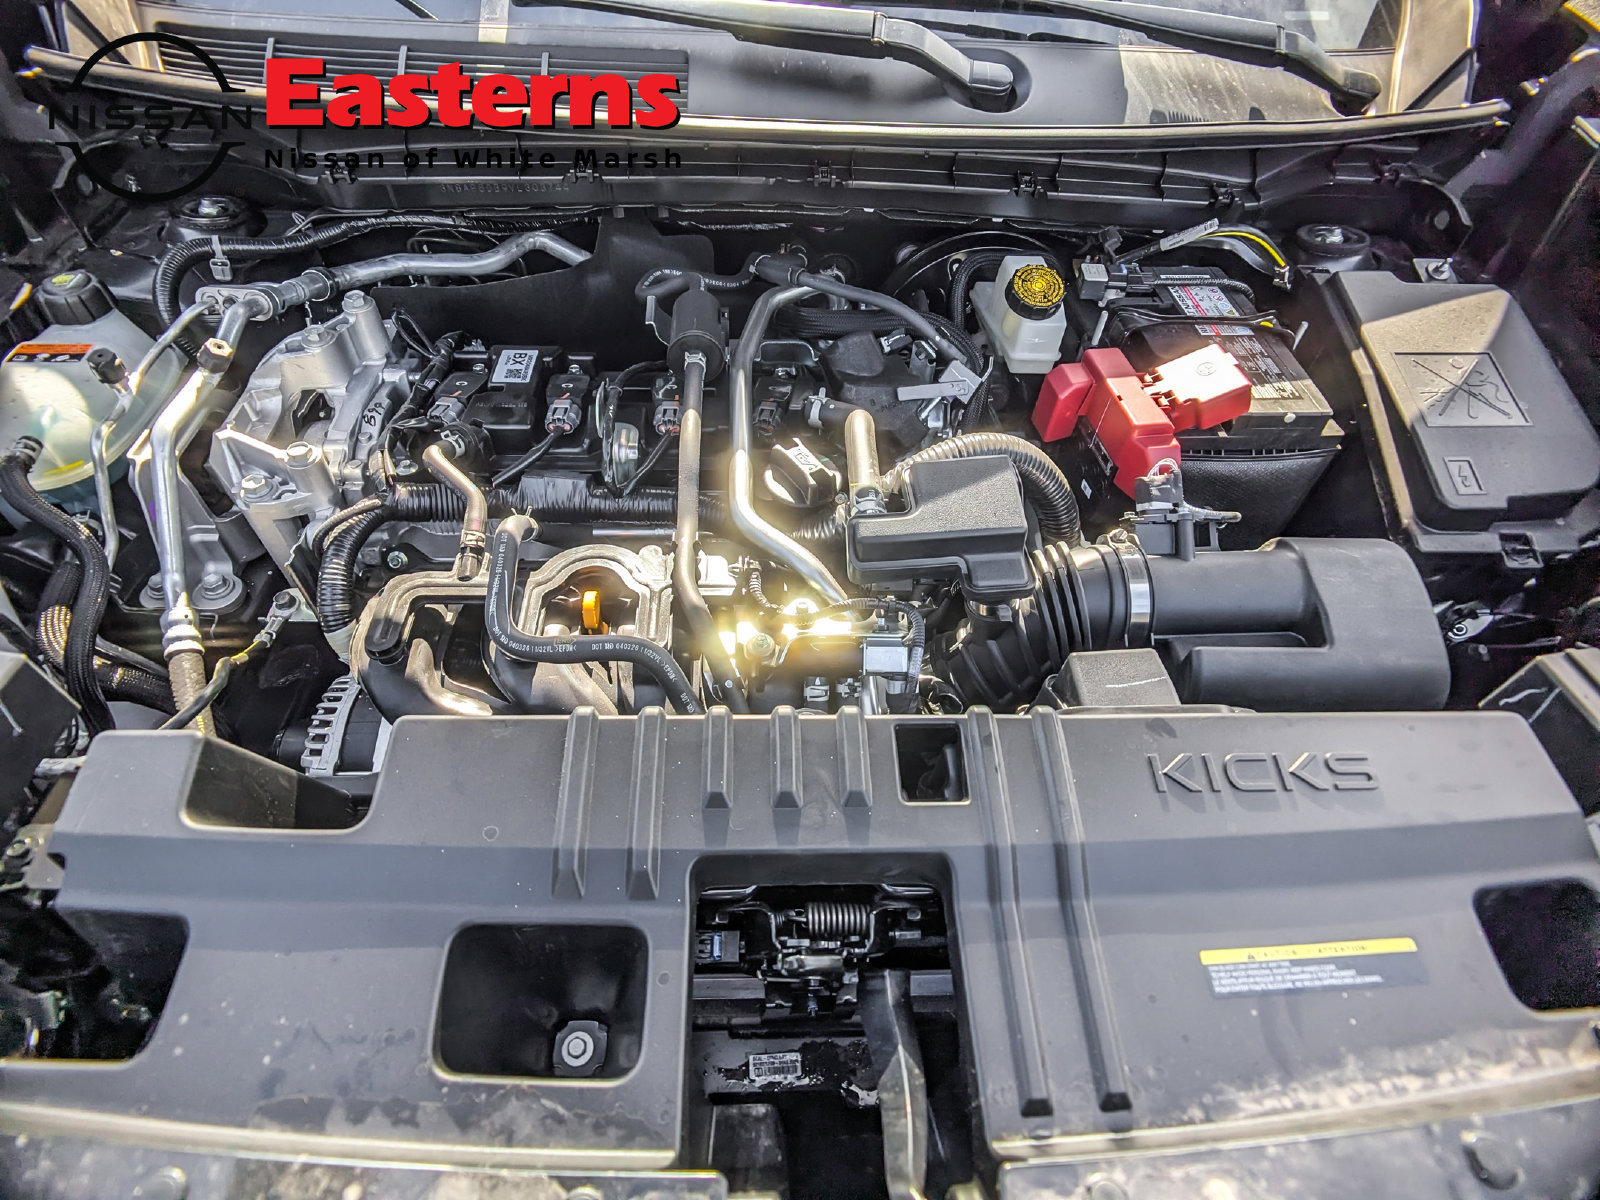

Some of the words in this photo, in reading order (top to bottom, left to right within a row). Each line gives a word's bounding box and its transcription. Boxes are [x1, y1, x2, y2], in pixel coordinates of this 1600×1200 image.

[510, 352, 528, 366] BX
[508, 642, 530, 652] 040326
[591, 643, 603, 651] DOT
[616, 643, 639, 652] 040326
[1145, 752, 1380, 793] KICKS
